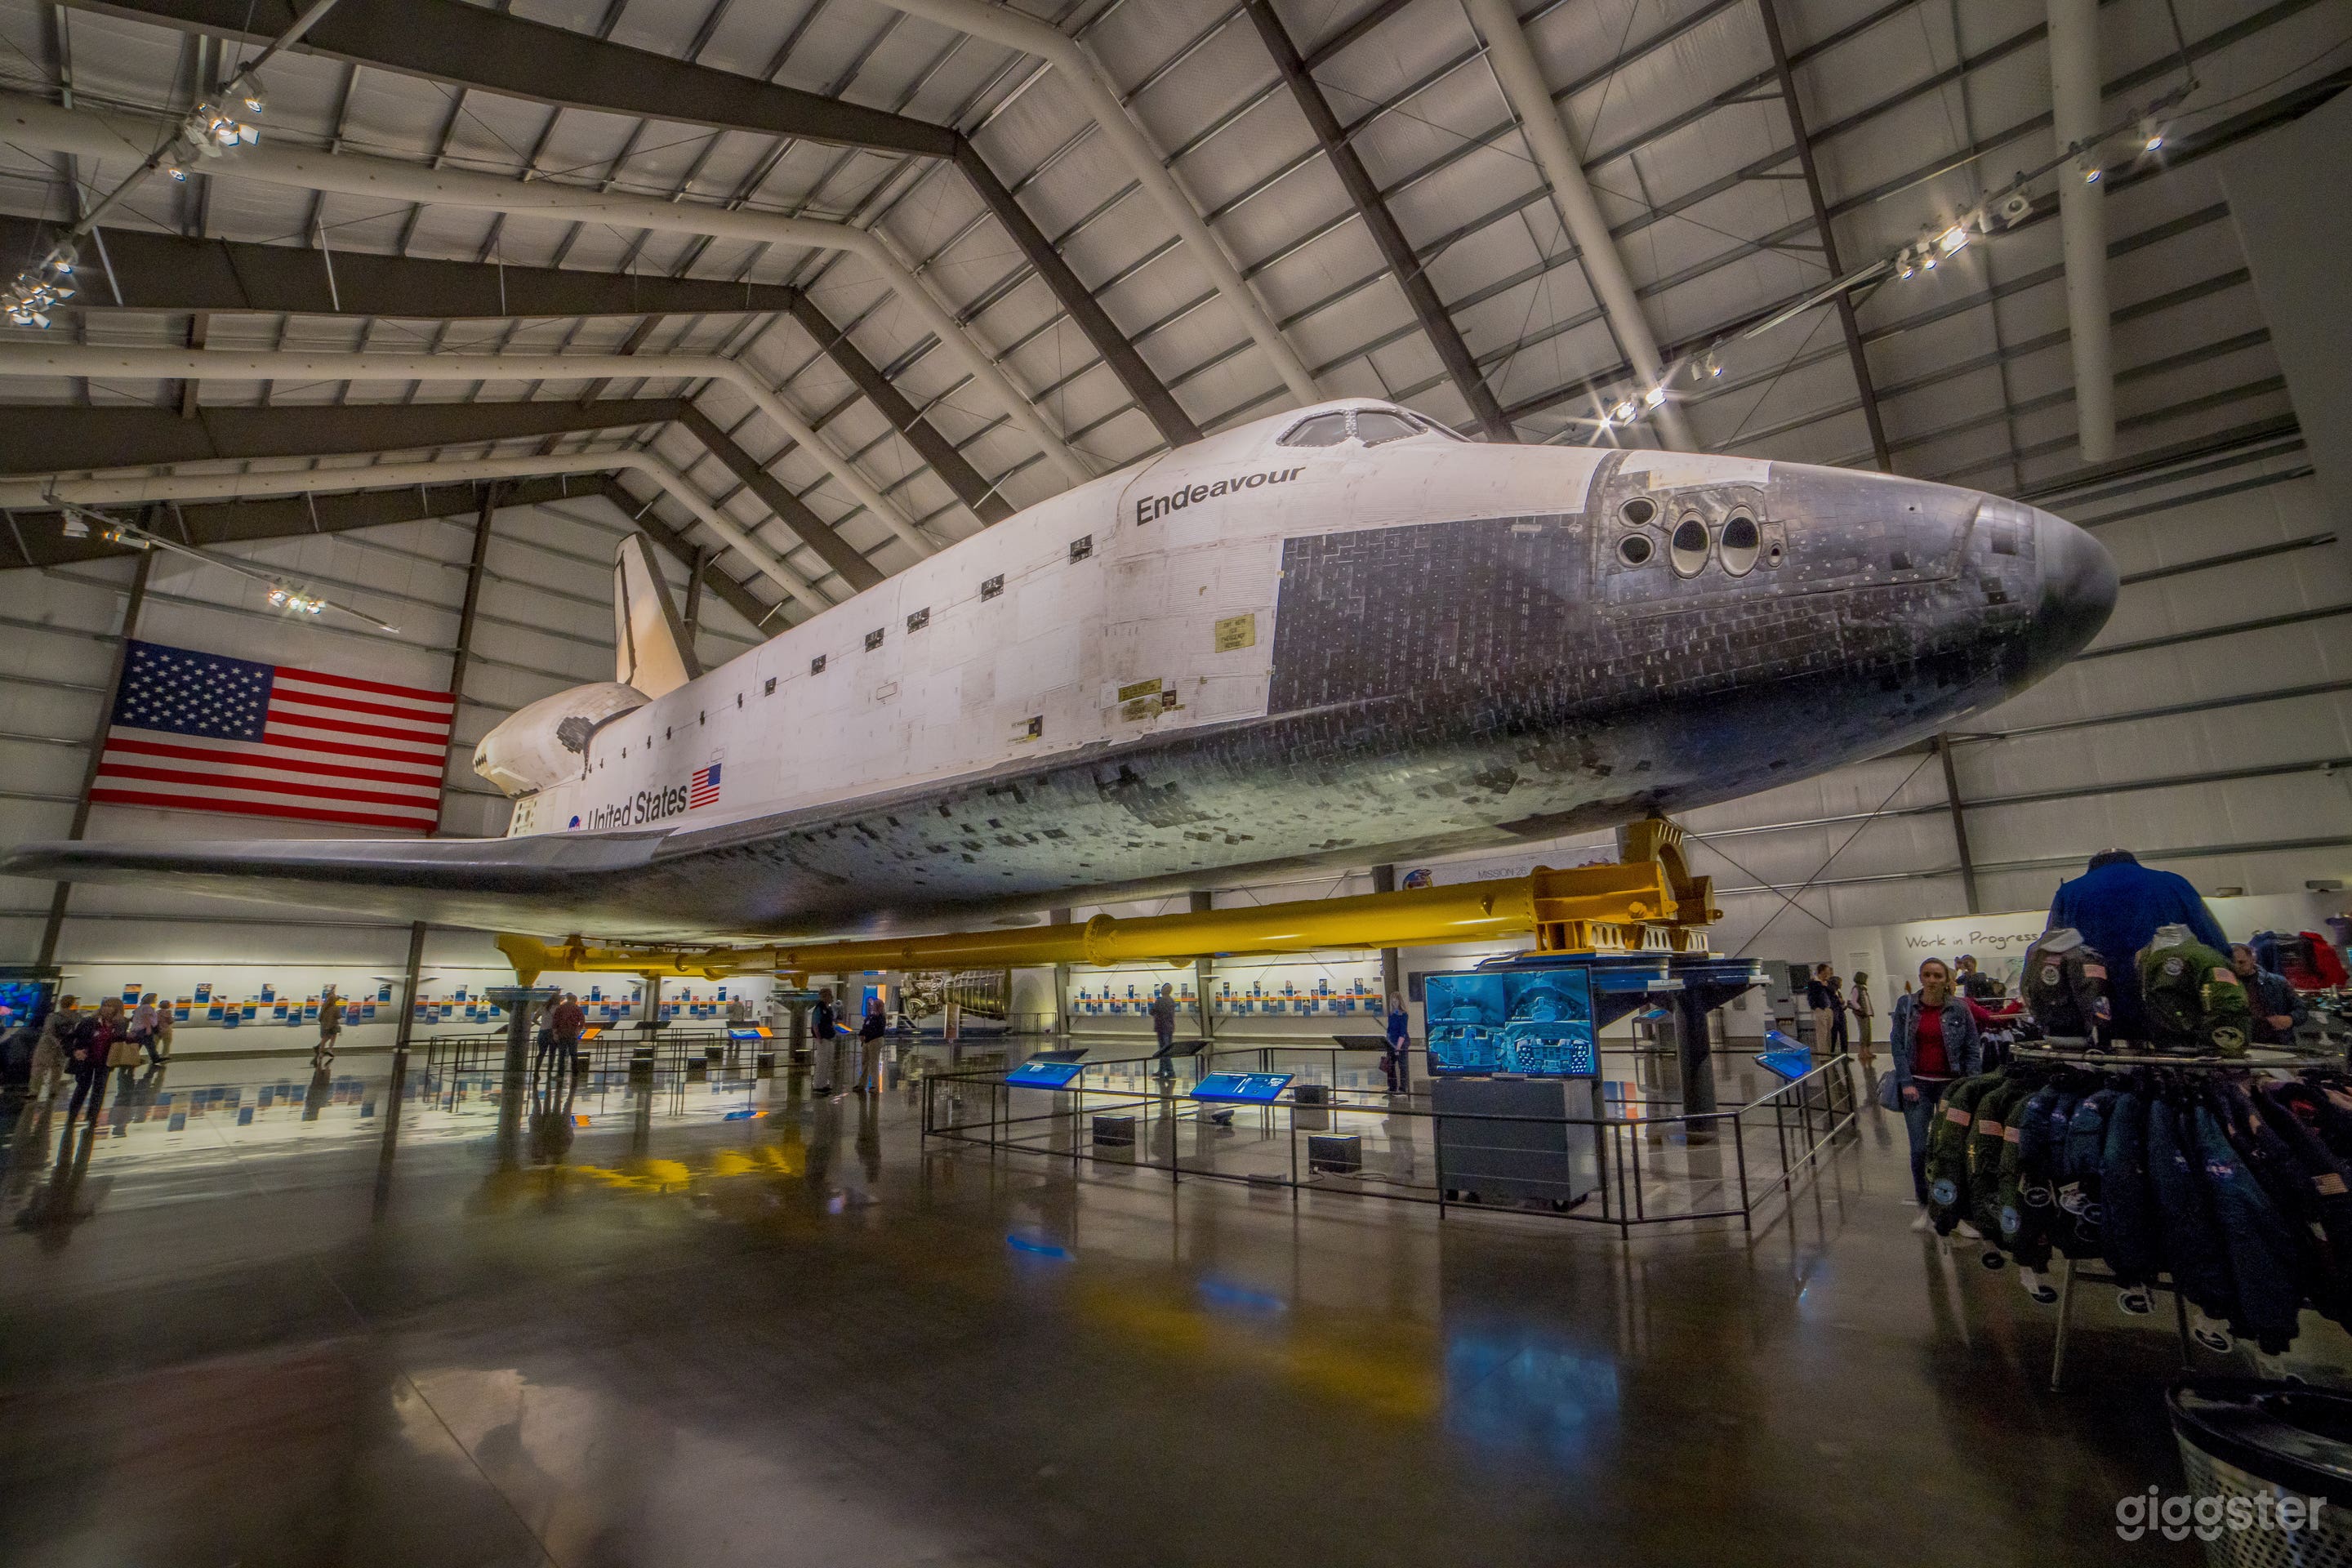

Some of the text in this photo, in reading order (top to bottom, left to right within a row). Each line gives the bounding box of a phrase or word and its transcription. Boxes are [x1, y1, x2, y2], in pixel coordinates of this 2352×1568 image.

[1136, 466, 1307, 527] Endeavour
[588, 785, 688, 831] United States
[1477, 867, 1514, 880] MISSION
[1905, 930, 2038, 951] Work in Progress
